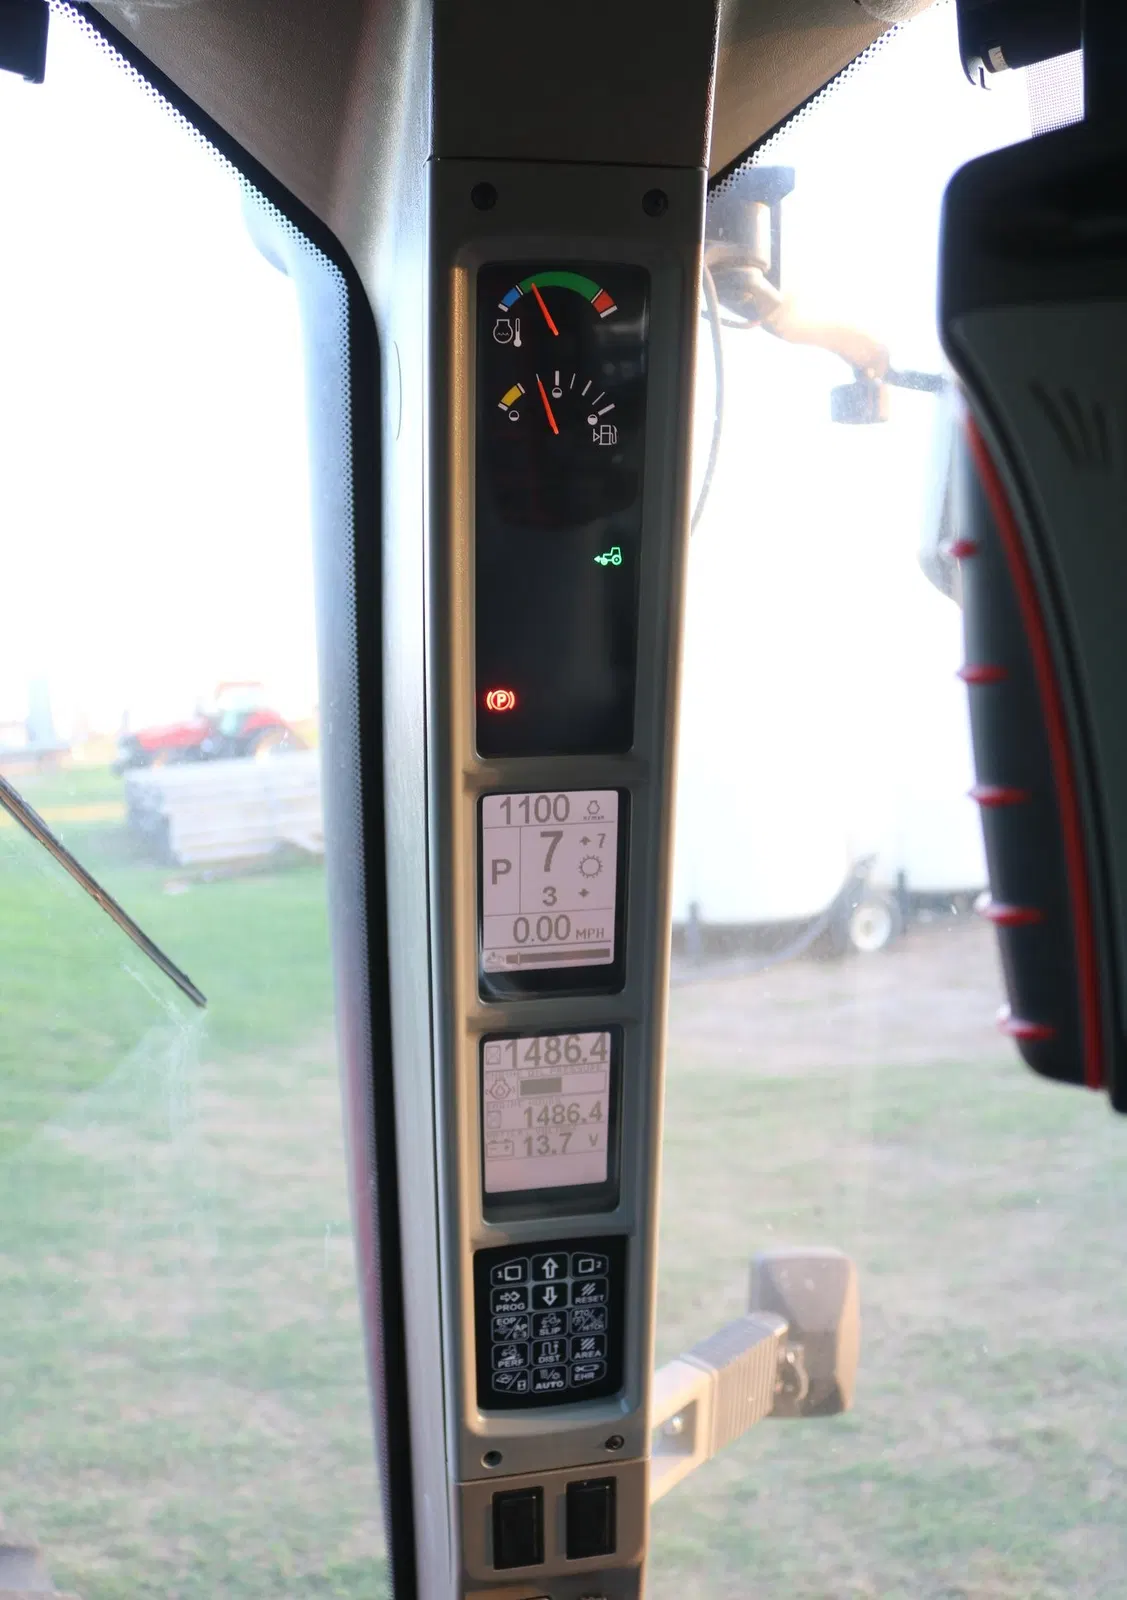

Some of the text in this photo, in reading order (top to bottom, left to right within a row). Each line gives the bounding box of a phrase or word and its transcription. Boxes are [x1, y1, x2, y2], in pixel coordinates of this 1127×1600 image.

[500, 794, 570, 824] 1100
[597, 833, 606, 849] 7
[540, 831, 564, 872] 7
[491, 859, 512, 884] P
[542, 886, 558, 907] 3
[513, 914, 605, 943] 0.00 MPH
[505, 1033, 608, 1068] 1486.4
[524, 1101, 603, 1128] 1486.4
[524, 1132, 573, 1157] 13.7
[575, 1294, 605, 1304] RESET
[496, 1303, 526, 1313] PROG
[539, 1327, 561, 1336] SLIP
[538, 1355, 561, 1364] DIST
[574, 1350, 602, 1359] AREA
[498, 1359, 524, 1369] PERF
[574, 1371, 596, 1381] EHR
[535, 1380, 564, 1390] AUTO
